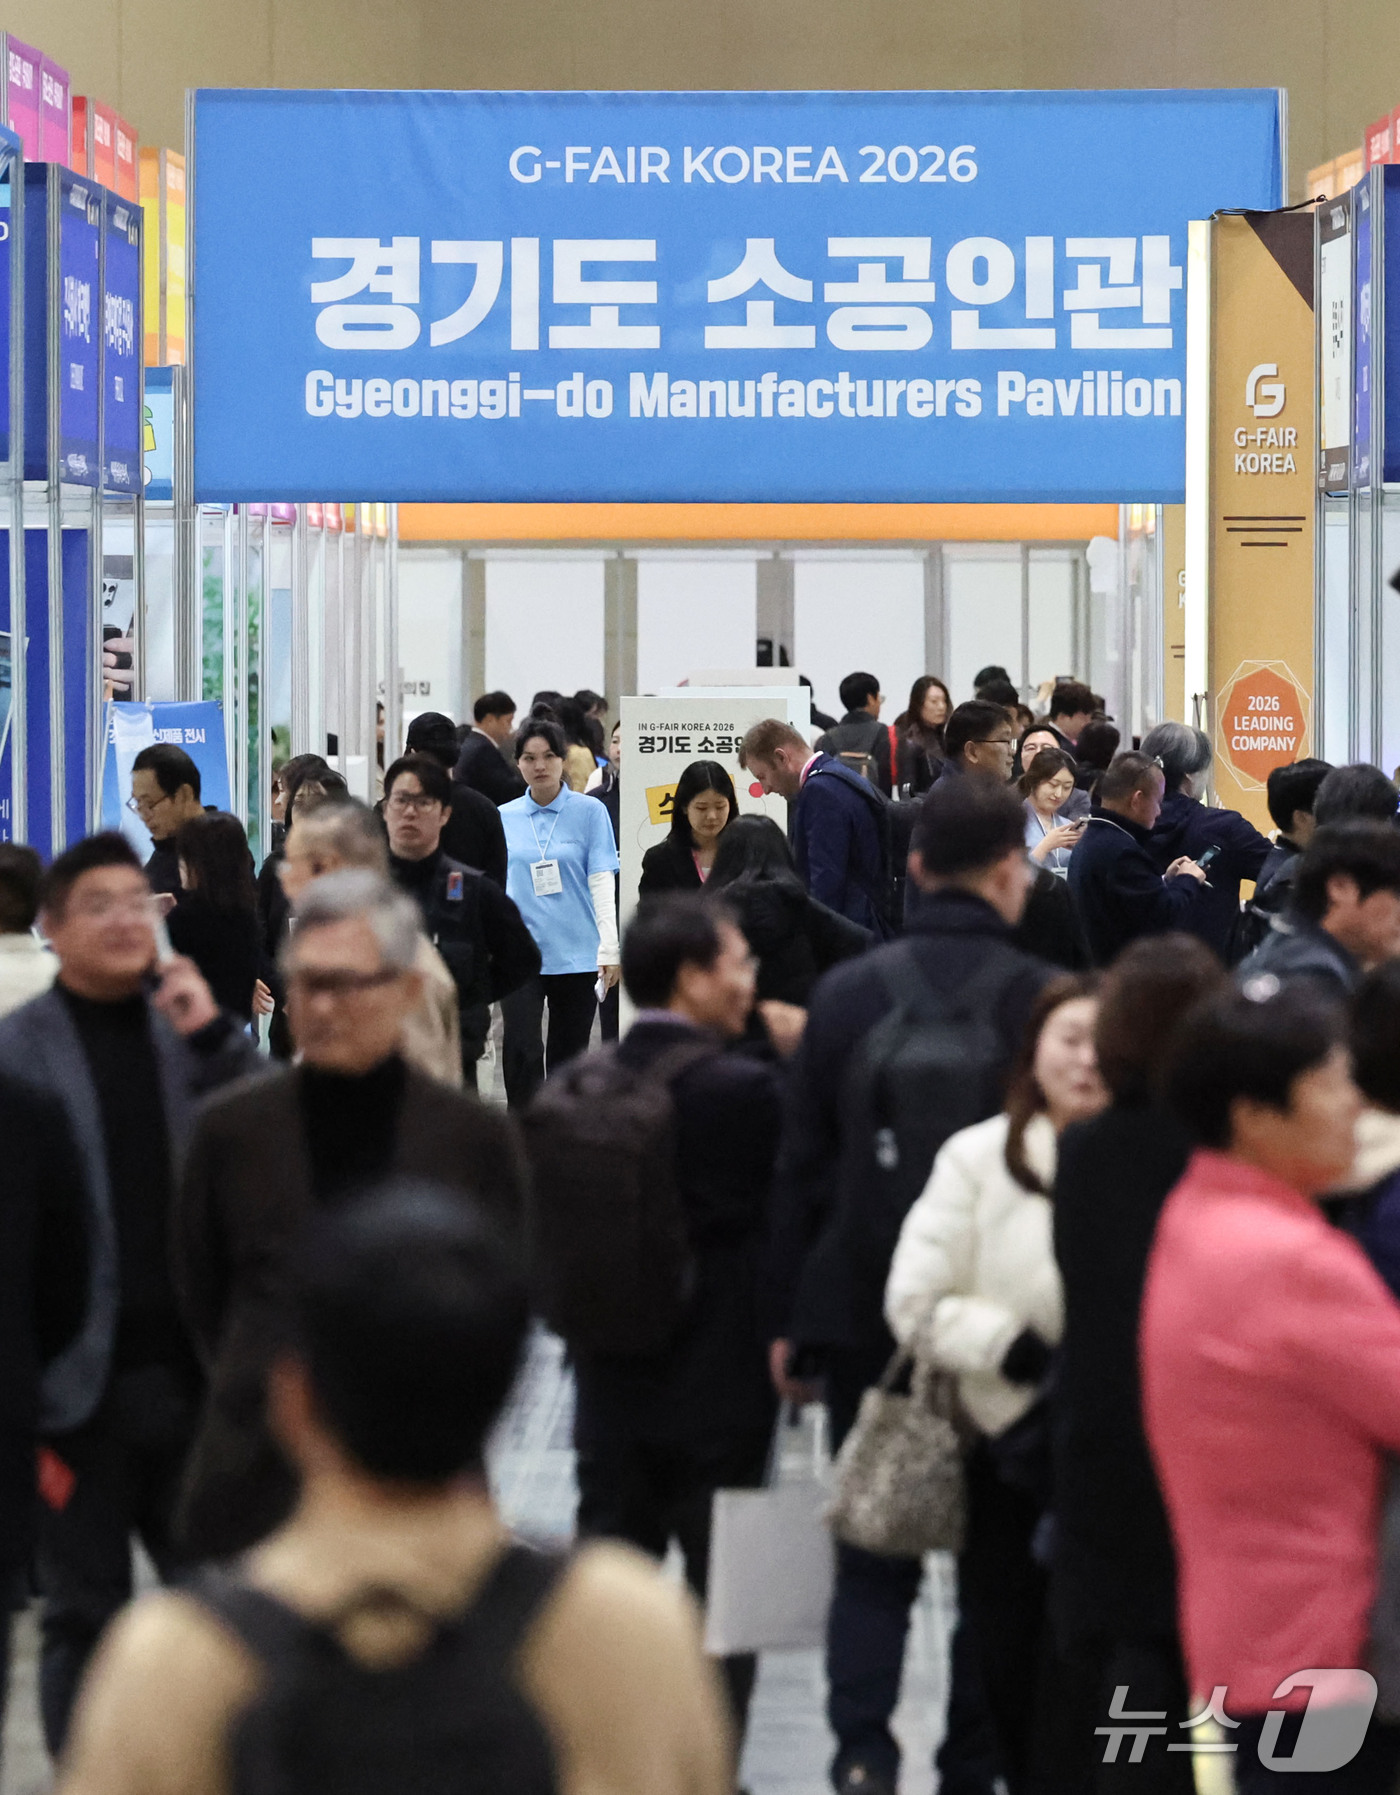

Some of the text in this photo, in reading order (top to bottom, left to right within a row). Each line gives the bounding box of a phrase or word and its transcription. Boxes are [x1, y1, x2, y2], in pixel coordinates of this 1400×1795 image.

[509, 144, 979, 184] G-FAIR KOREA 2026
[310, 235, 1183, 351] 경기도 소공인관
[305, 369, 1182, 420] Gyeonggi-do Manufacturers Pavilion
[1234, 426, 1297, 448] G-FAIR
[1234, 452, 1297, 474] KOREA
[1247, 696, 1280, 711] 2026
[638, 722, 735, 731] IN G-FAIR KOREA 2026
[1234, 716, 1294, 732] LEADING
[638, 735, 692, 754] 경기도
[1231, 735, 1296, 751] COMPANY
